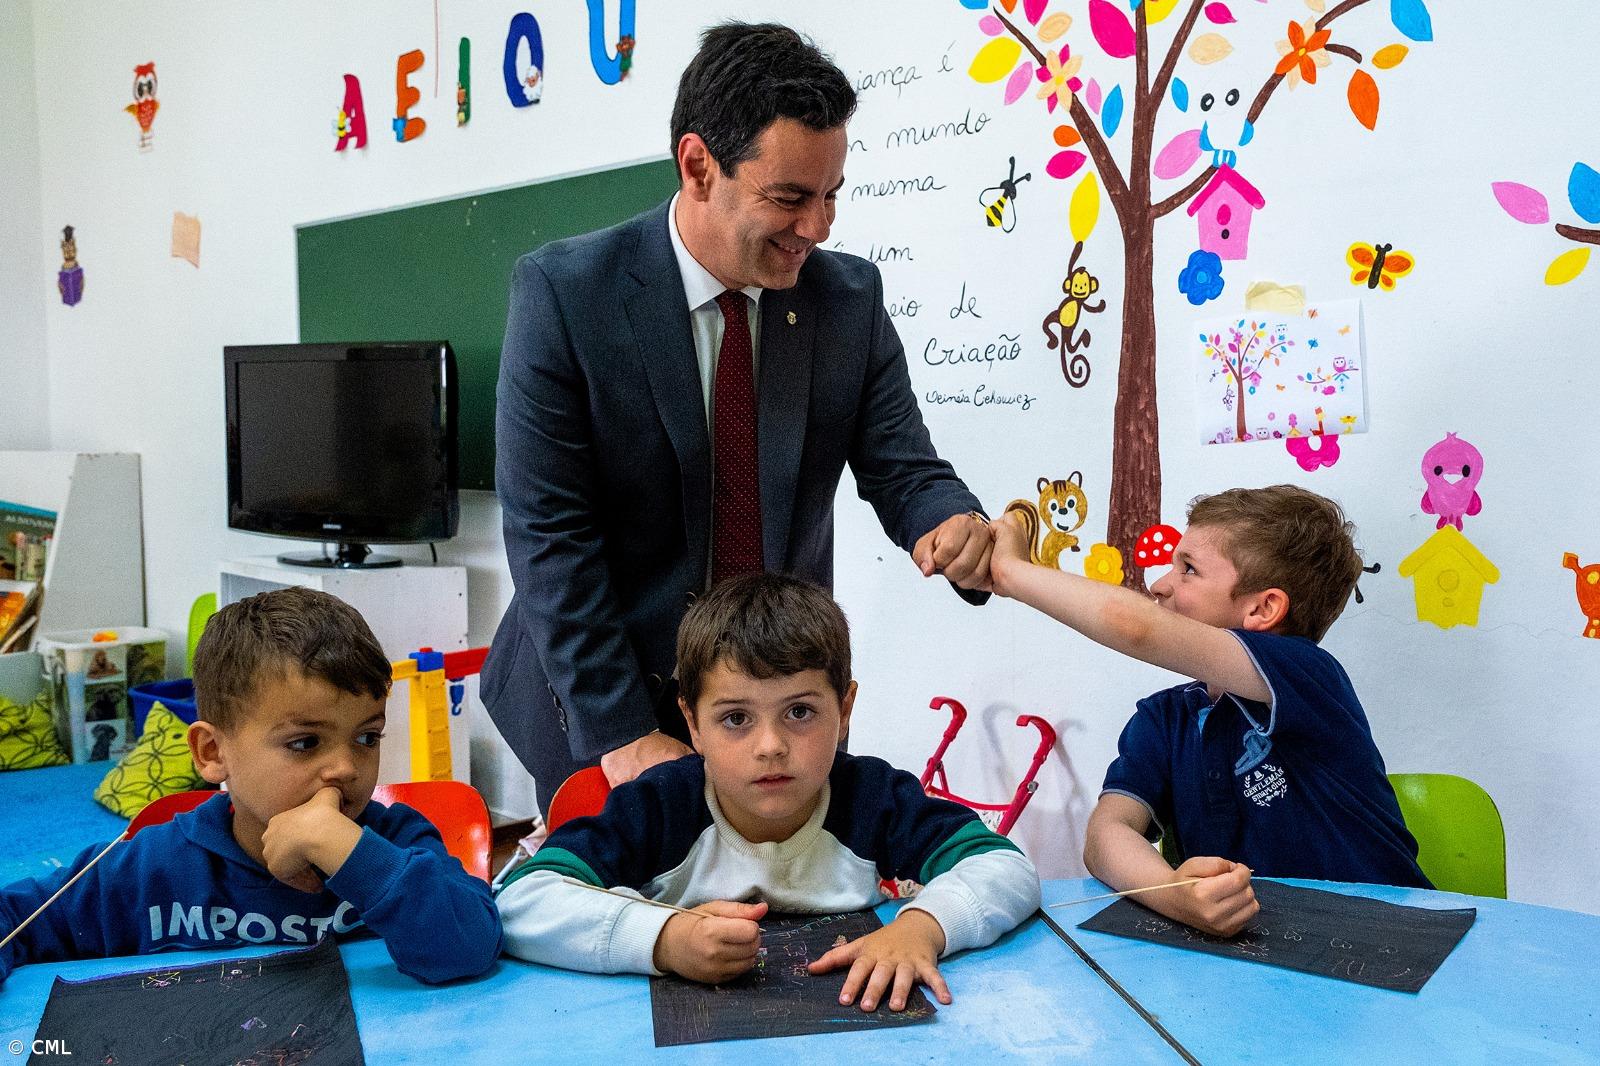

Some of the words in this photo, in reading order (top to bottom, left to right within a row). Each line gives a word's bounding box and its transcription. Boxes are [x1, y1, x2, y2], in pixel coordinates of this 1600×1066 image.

[856, 66, 923, 98] iança
[886, 108, 991, 149] mundo
[851, 175, 947, 202] mesma
[889, 296, 923, 318] eio
[949, 281, 983, 319] de
[923, 333, 1022, 372] Criação
[1243, 766, 1285, 798] GENTLEMAN
